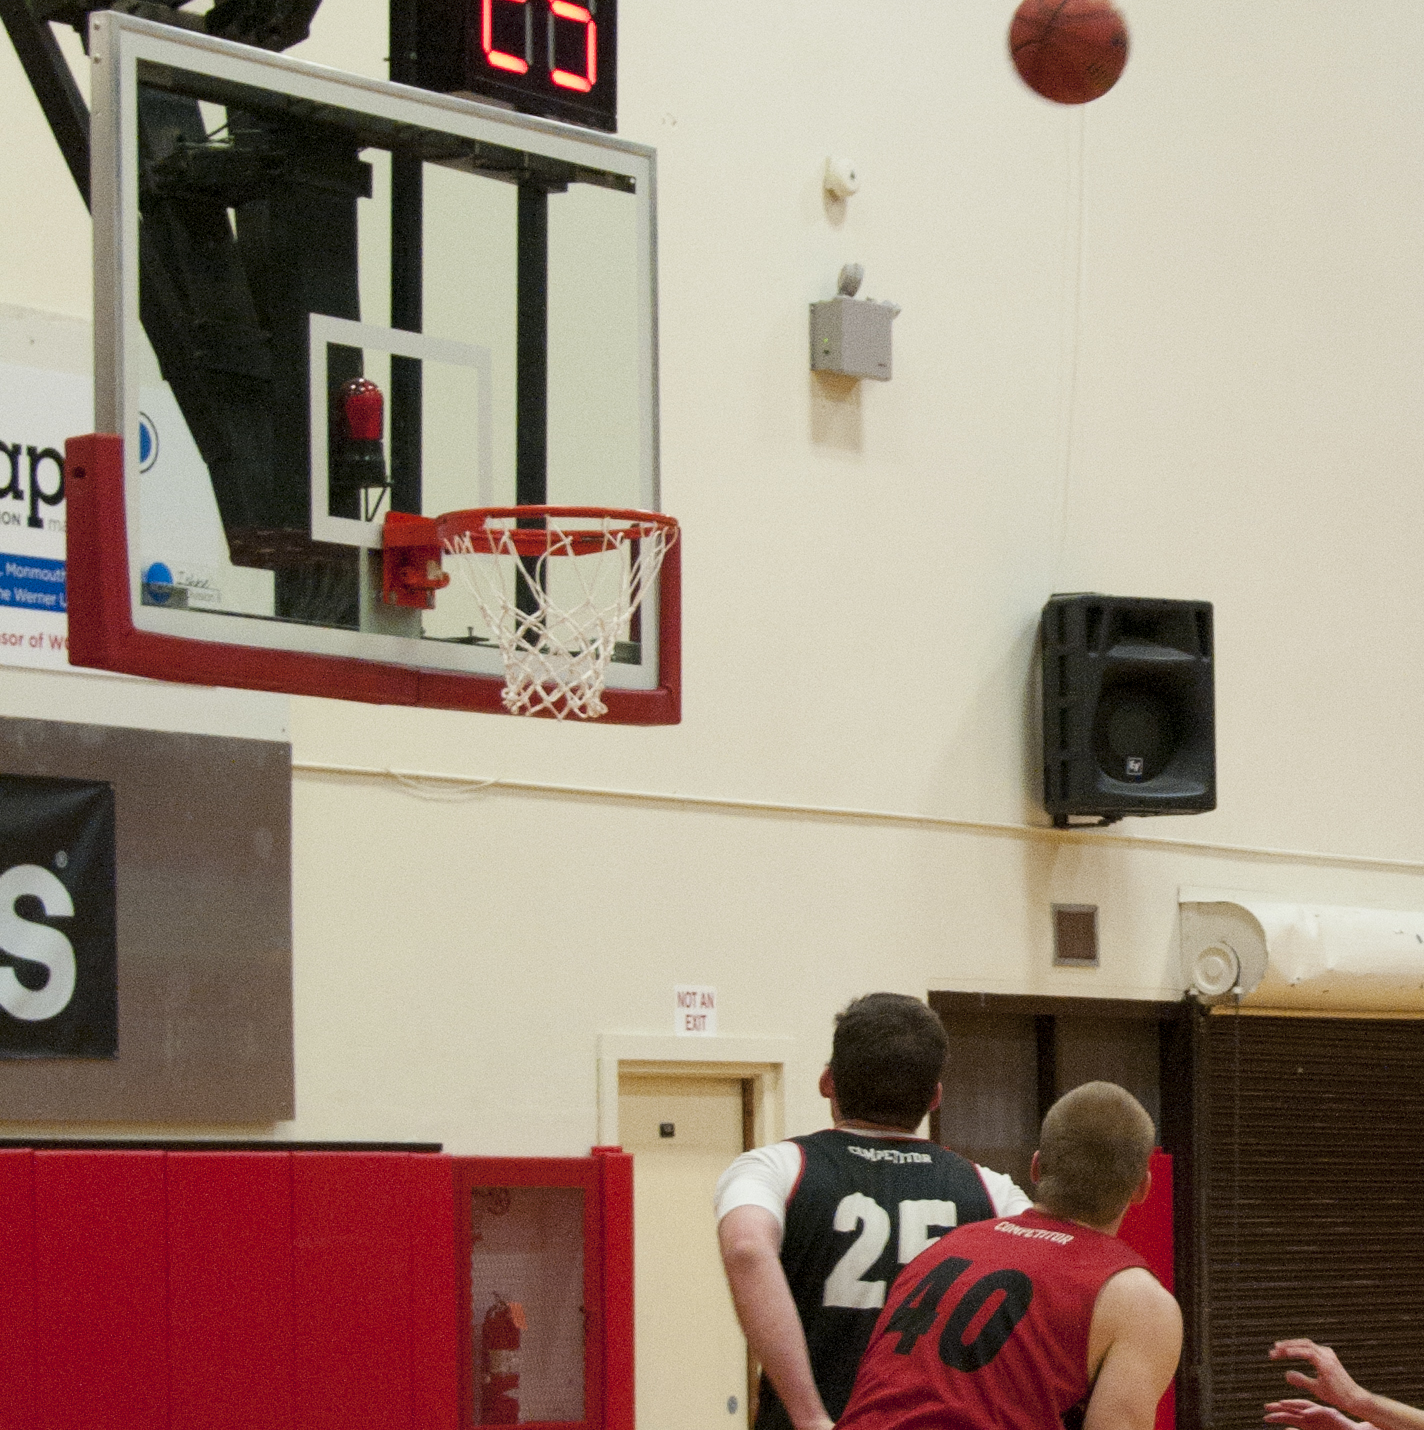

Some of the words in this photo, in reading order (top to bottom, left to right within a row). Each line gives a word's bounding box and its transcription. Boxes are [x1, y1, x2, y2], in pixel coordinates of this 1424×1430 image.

[29, 632, 44, 649] of
[677, 991, 697, 1008] NOT
[701, 992, 714, 1008] AN
[685, 1014, 706, 1031] EXIT
[994, 1220, 1075, 1246] COMPETITOR
[884, 1256, 1034, 1373] 40
